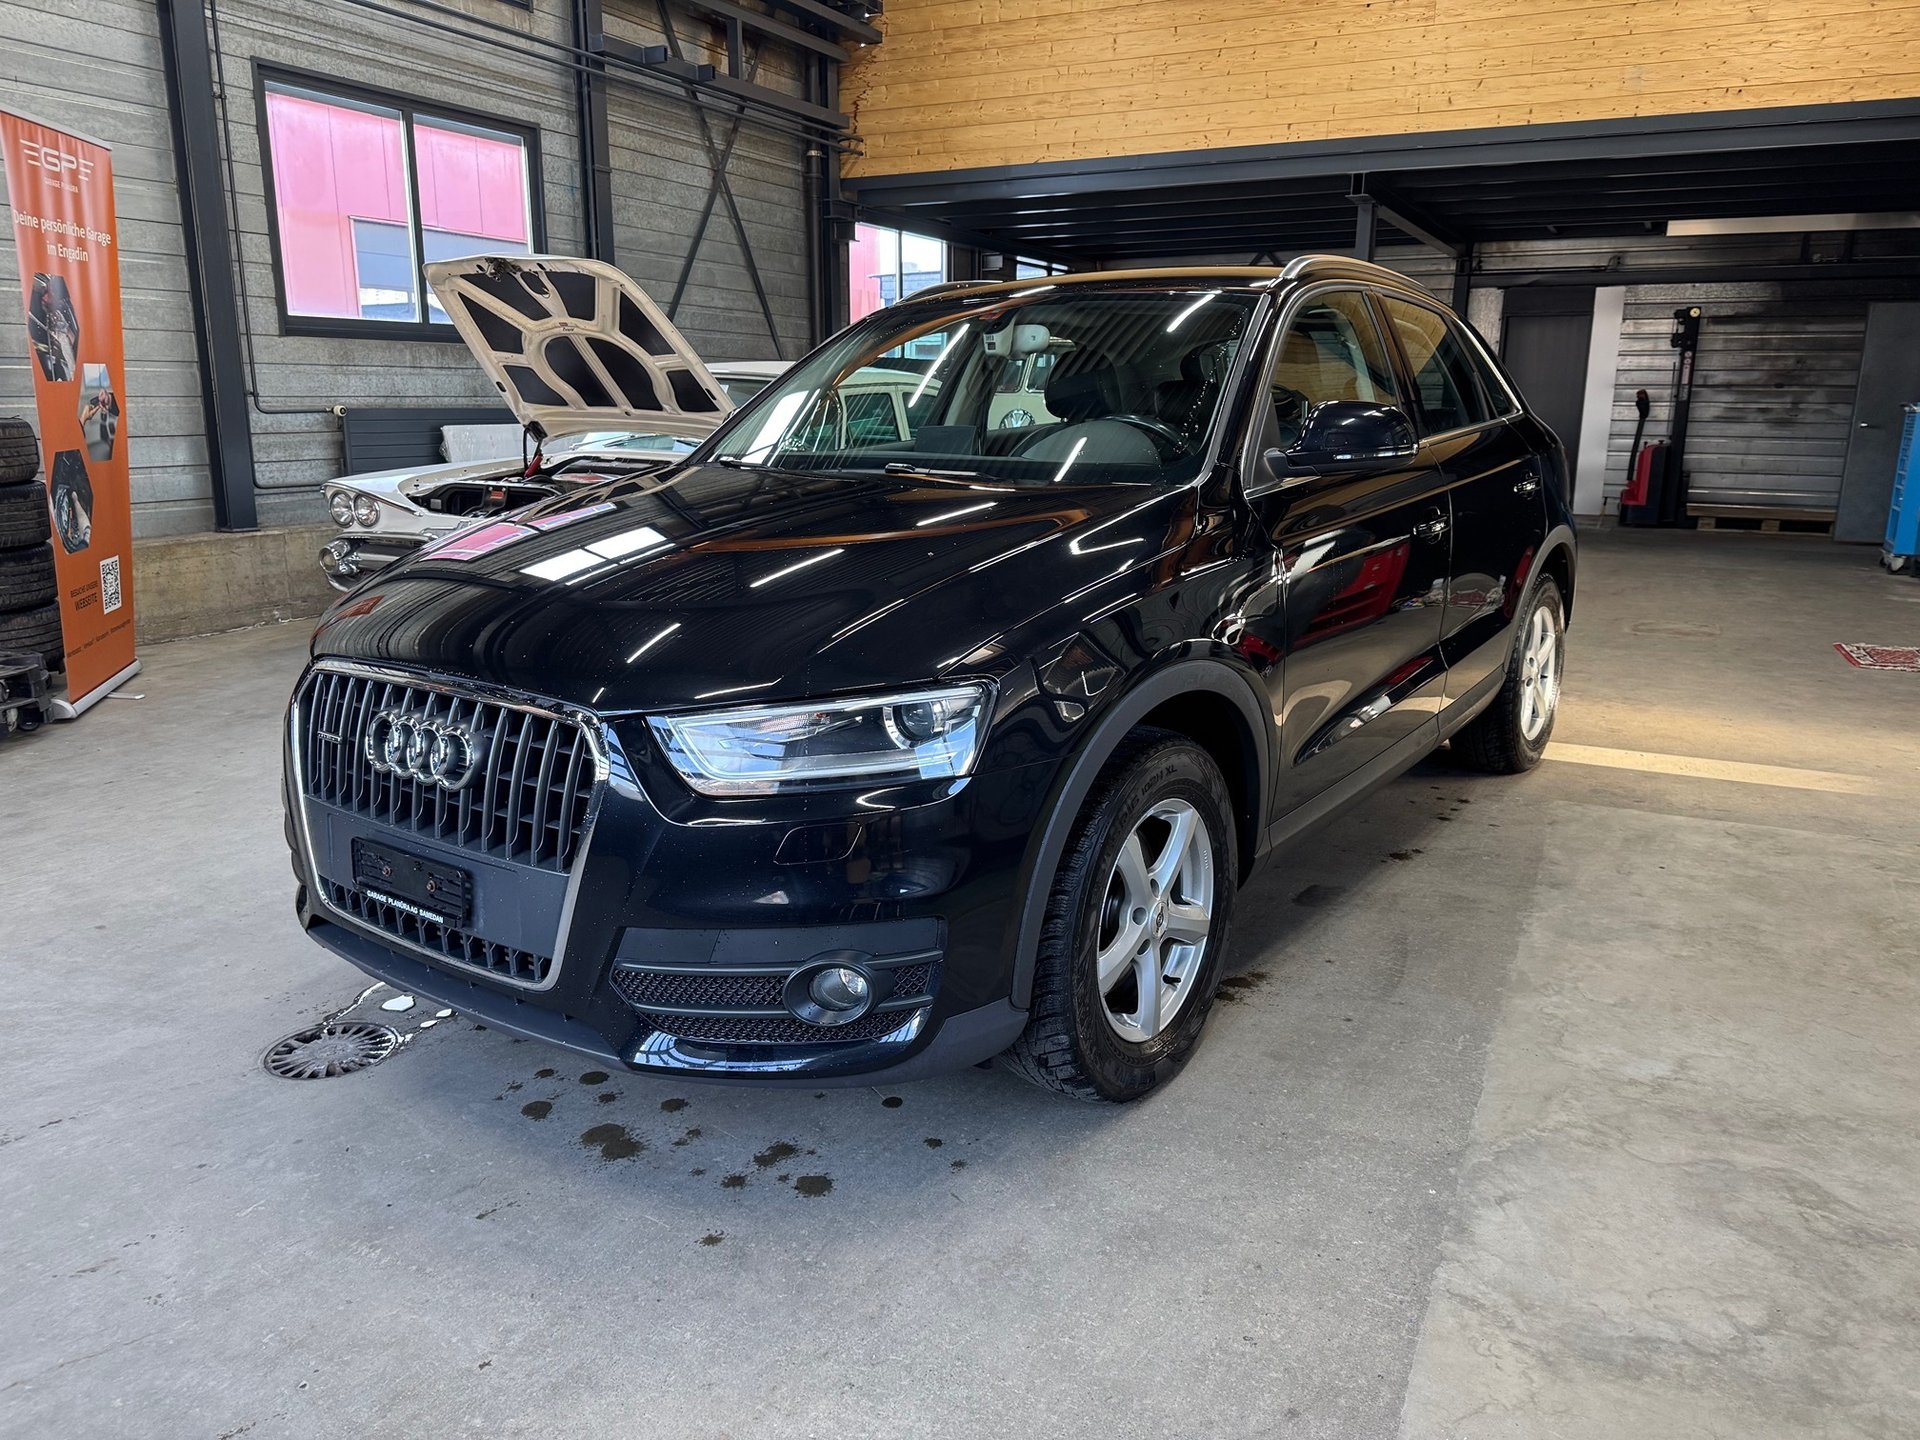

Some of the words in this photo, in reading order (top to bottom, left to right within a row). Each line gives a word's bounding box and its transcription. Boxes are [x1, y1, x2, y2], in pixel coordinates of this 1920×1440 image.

[13, 209, 39, 228] Deine
[40, 218, 85, 238] persönliche
[86, 226, 111, 247] Garage
[46, 240, 57, 256] im
[57, 243, 89, 262] Engadin
[366, 889, 387, 903] GARAGE
[419, 909, 444, 924] SAMEDAN
